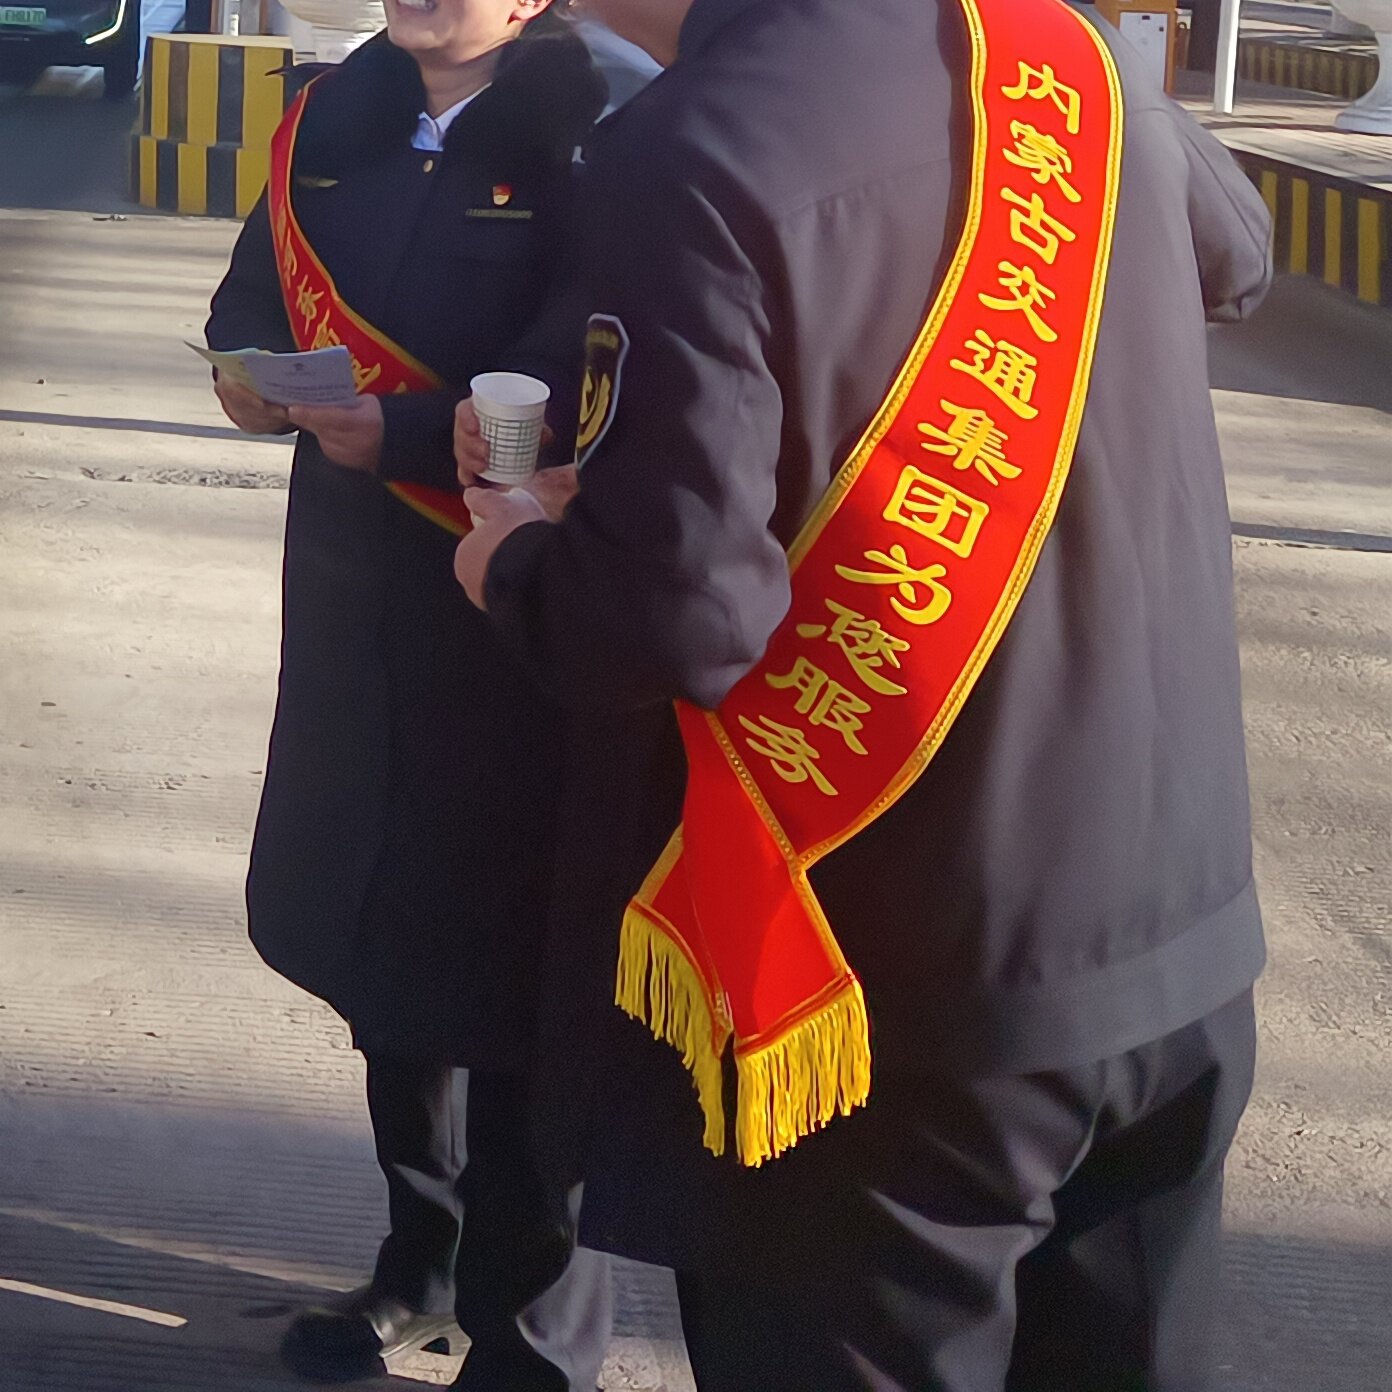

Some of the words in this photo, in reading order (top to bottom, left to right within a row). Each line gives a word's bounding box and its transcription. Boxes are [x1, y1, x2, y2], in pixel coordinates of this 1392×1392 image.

[737, 59, 1081, 797] 内蒙古交通集团为您服务
